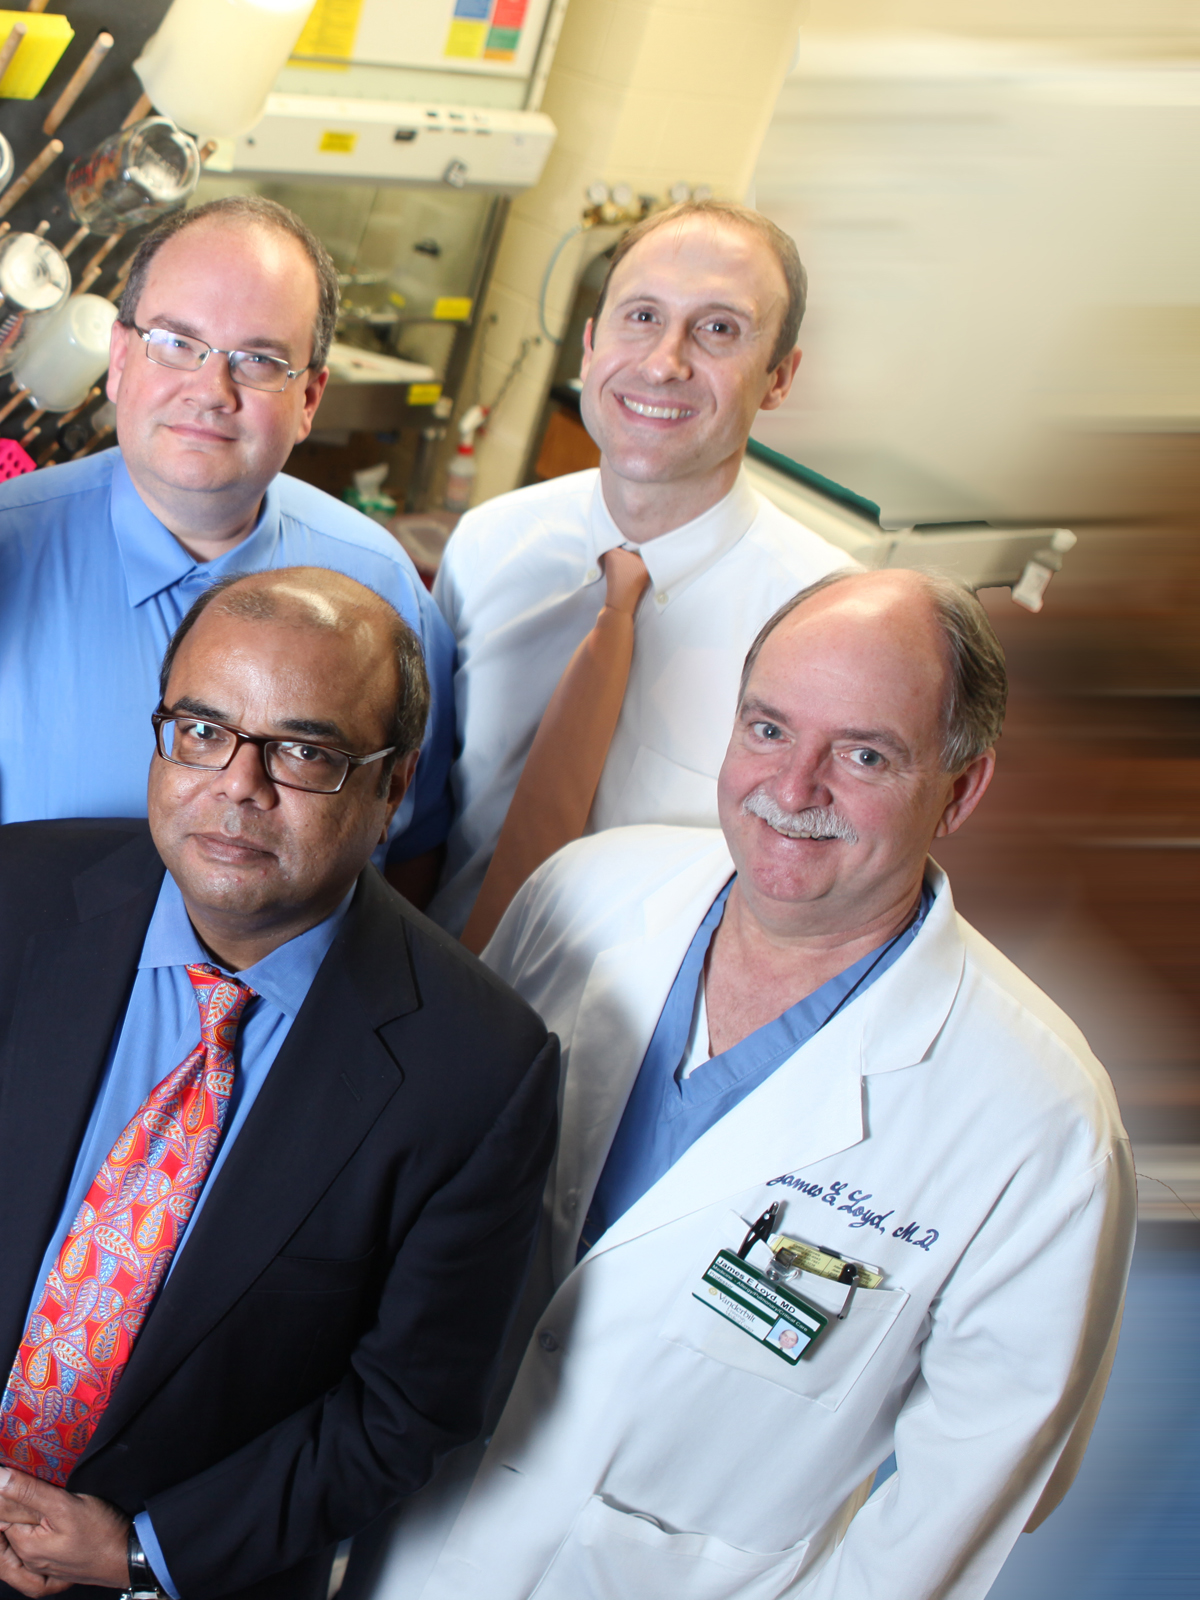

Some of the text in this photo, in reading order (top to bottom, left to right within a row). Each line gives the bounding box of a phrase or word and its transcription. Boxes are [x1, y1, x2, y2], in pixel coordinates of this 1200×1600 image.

[837, 1190, 895, 1235] Loyd,
[709, 1271, 733, 1289] Professor
[717, 1259, 796, 1314] James E Loyd, MD
[719, 1292, 756, 1322] Vanderbilt
[795, 1321, 808, 1331] Care
